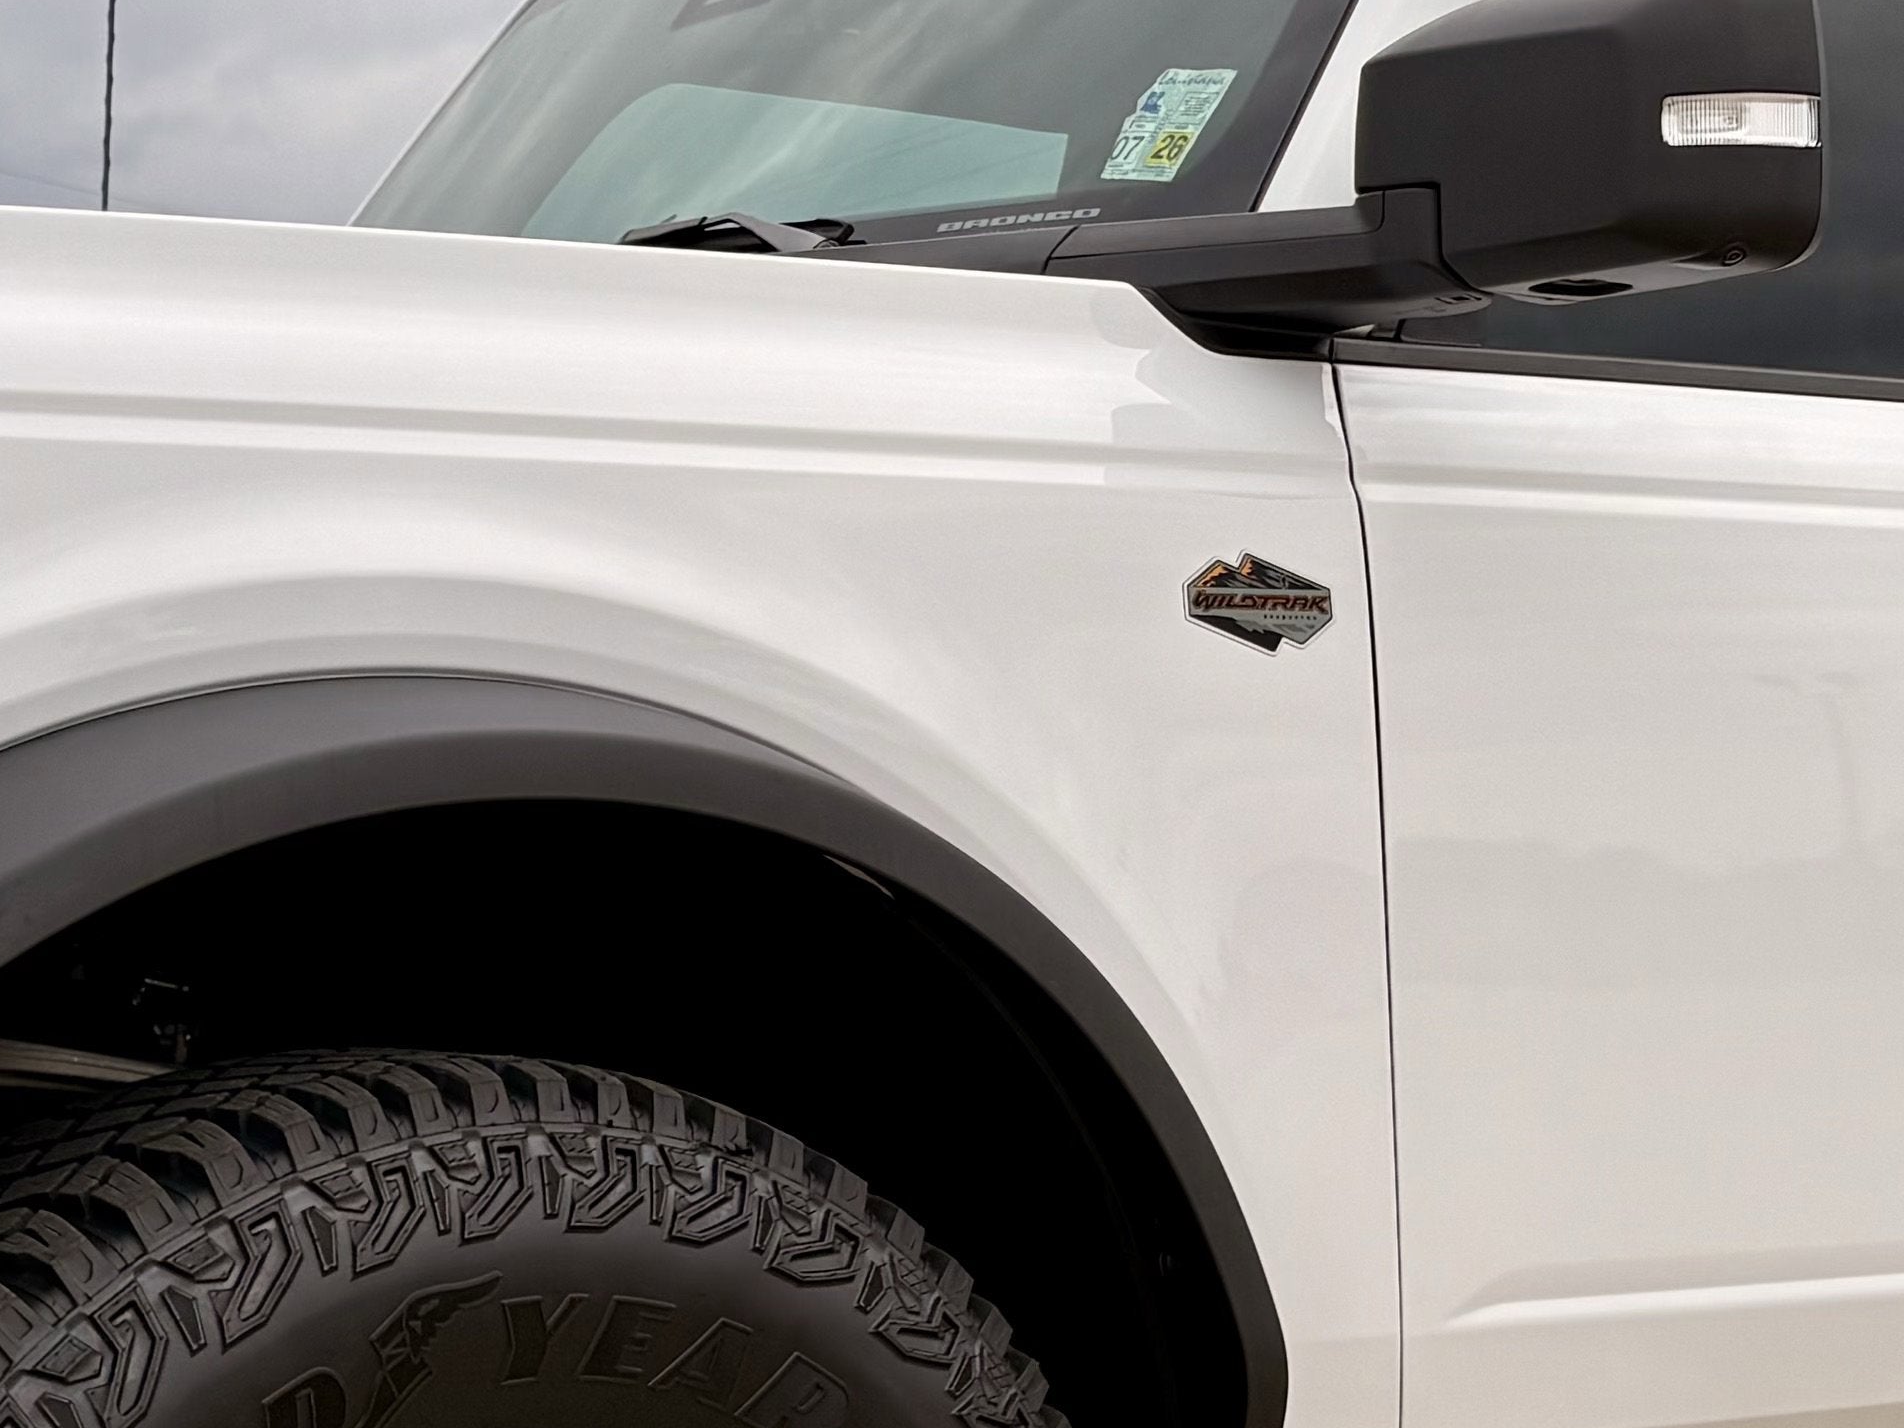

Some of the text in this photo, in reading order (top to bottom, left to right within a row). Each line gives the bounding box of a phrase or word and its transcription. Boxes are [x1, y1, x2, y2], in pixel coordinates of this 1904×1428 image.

[1109, 134, 1189, 162] 07 26
[936, 207, 1102, 233] BRONCO
[1192, 589, 1331, 615] WILDTRAK
